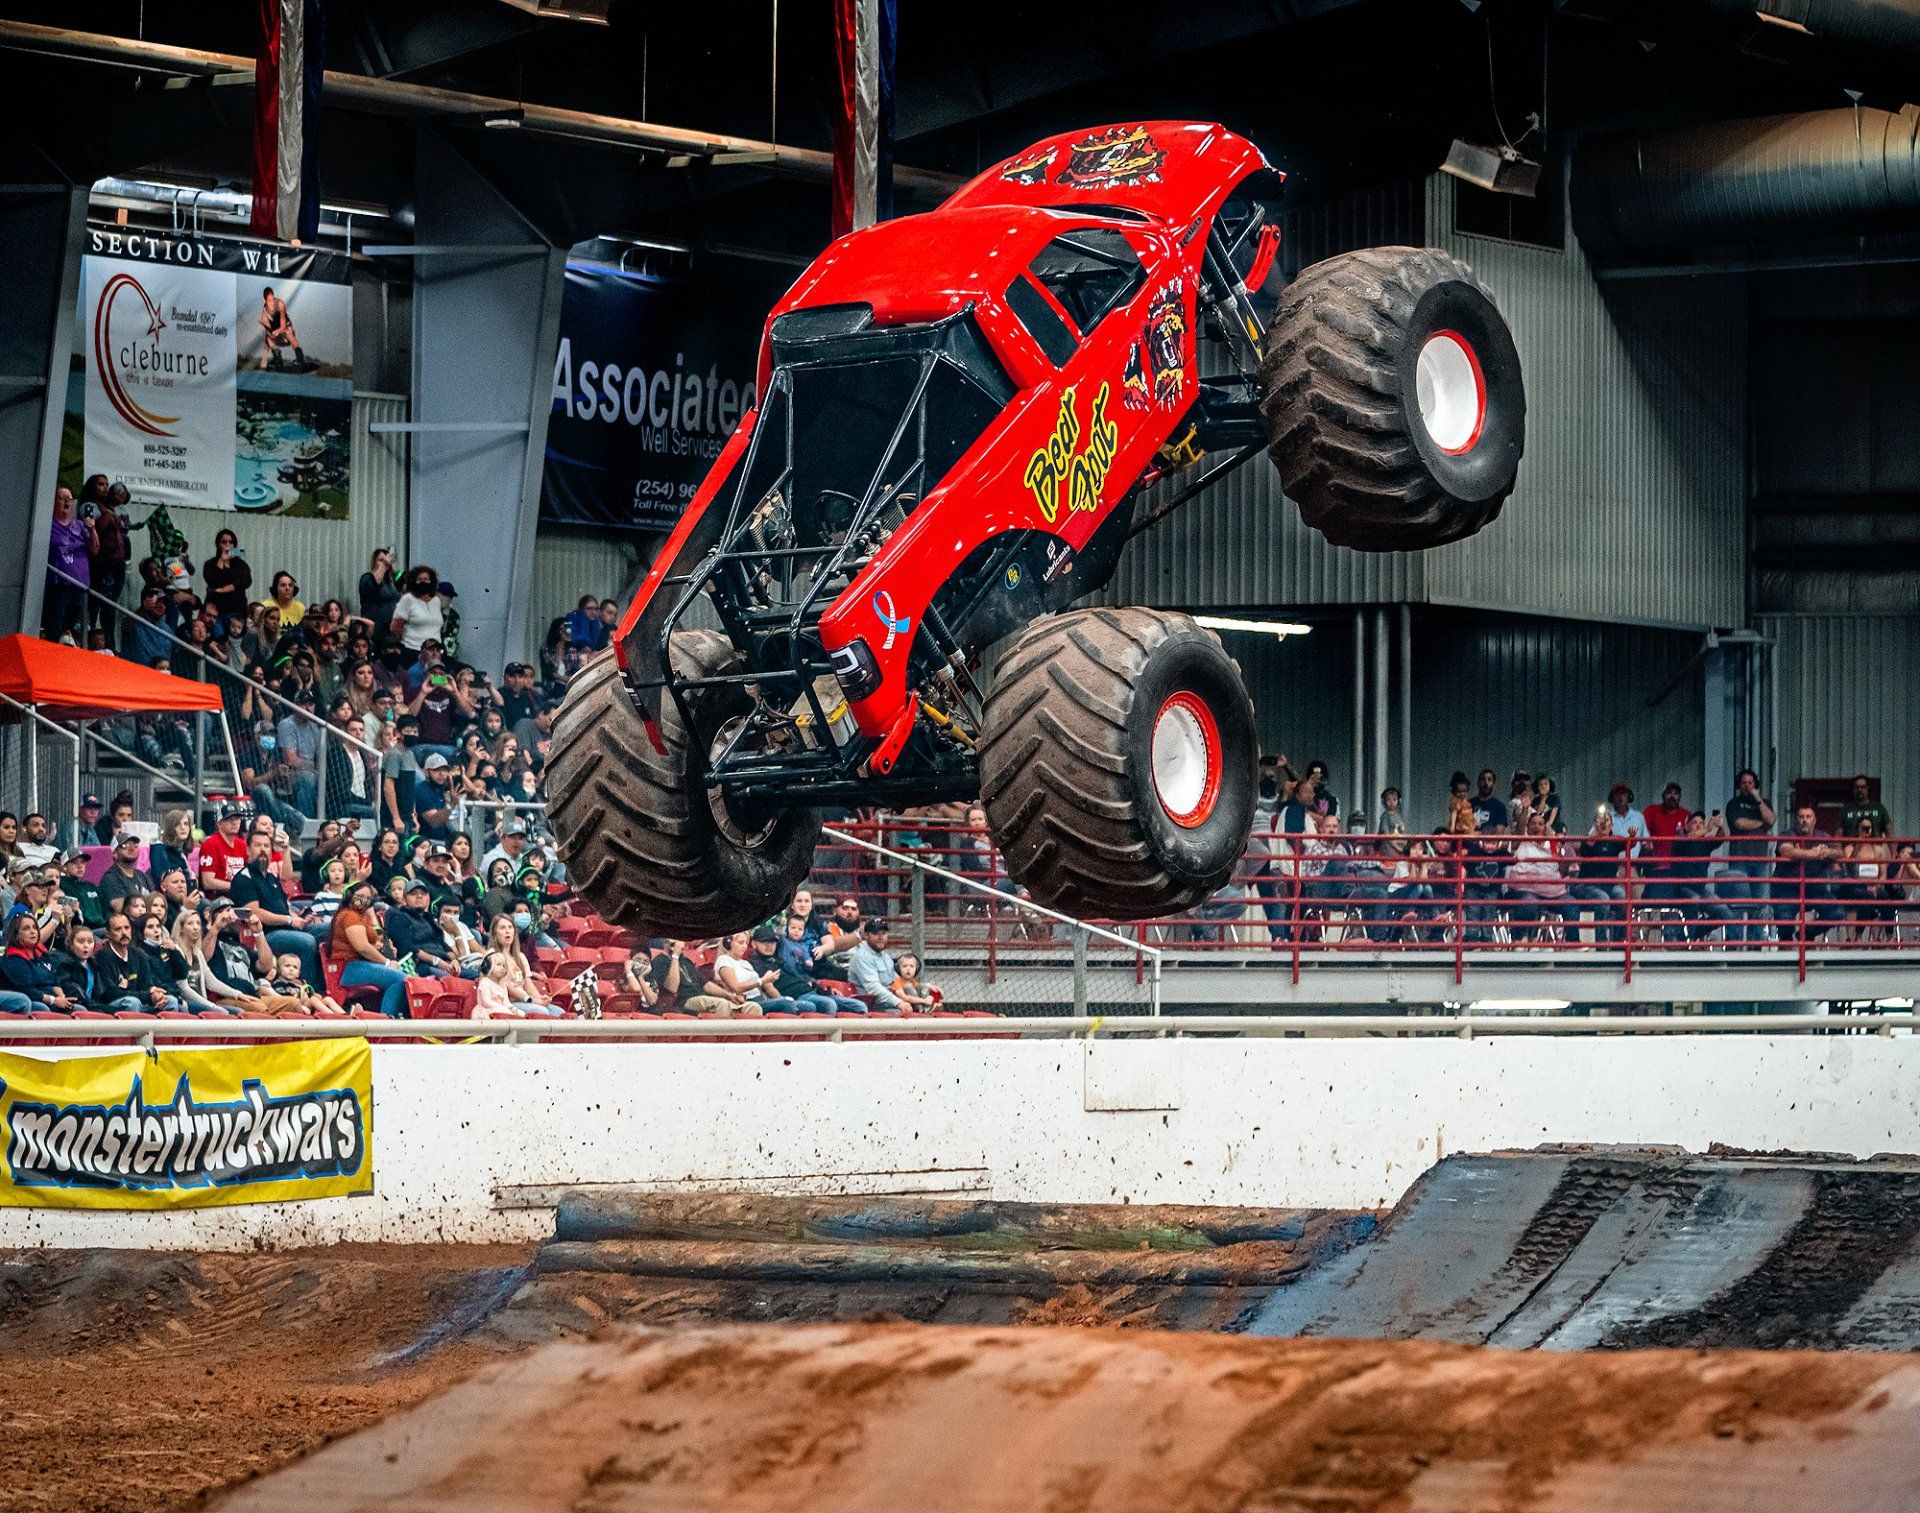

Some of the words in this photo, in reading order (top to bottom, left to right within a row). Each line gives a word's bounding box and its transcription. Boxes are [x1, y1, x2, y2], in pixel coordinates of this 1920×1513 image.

[92, 231, 214, 266] SECTION
[199, 311, 217, 325] 1867
[214, 326, 228, 338] daily
[120, 342, 209, 376] cleburne
[125, 371, 140, 385] this
[152, 376, 175, 388] texas
[641, 425, 668, 454] Well
[672, 429, 723, 459] Services
[1023, 384, 1080, 524] Bear
[1068, 379, 1118, 513] Foot
[633, 498, 653, 511] Toll
[654, 500, 679, 513] Free
[635, 478, 675, 500] (254)
[1042, 544, 1071, 582] Lubricants
[10, 1086, 357, 1177] monstertruckwars
